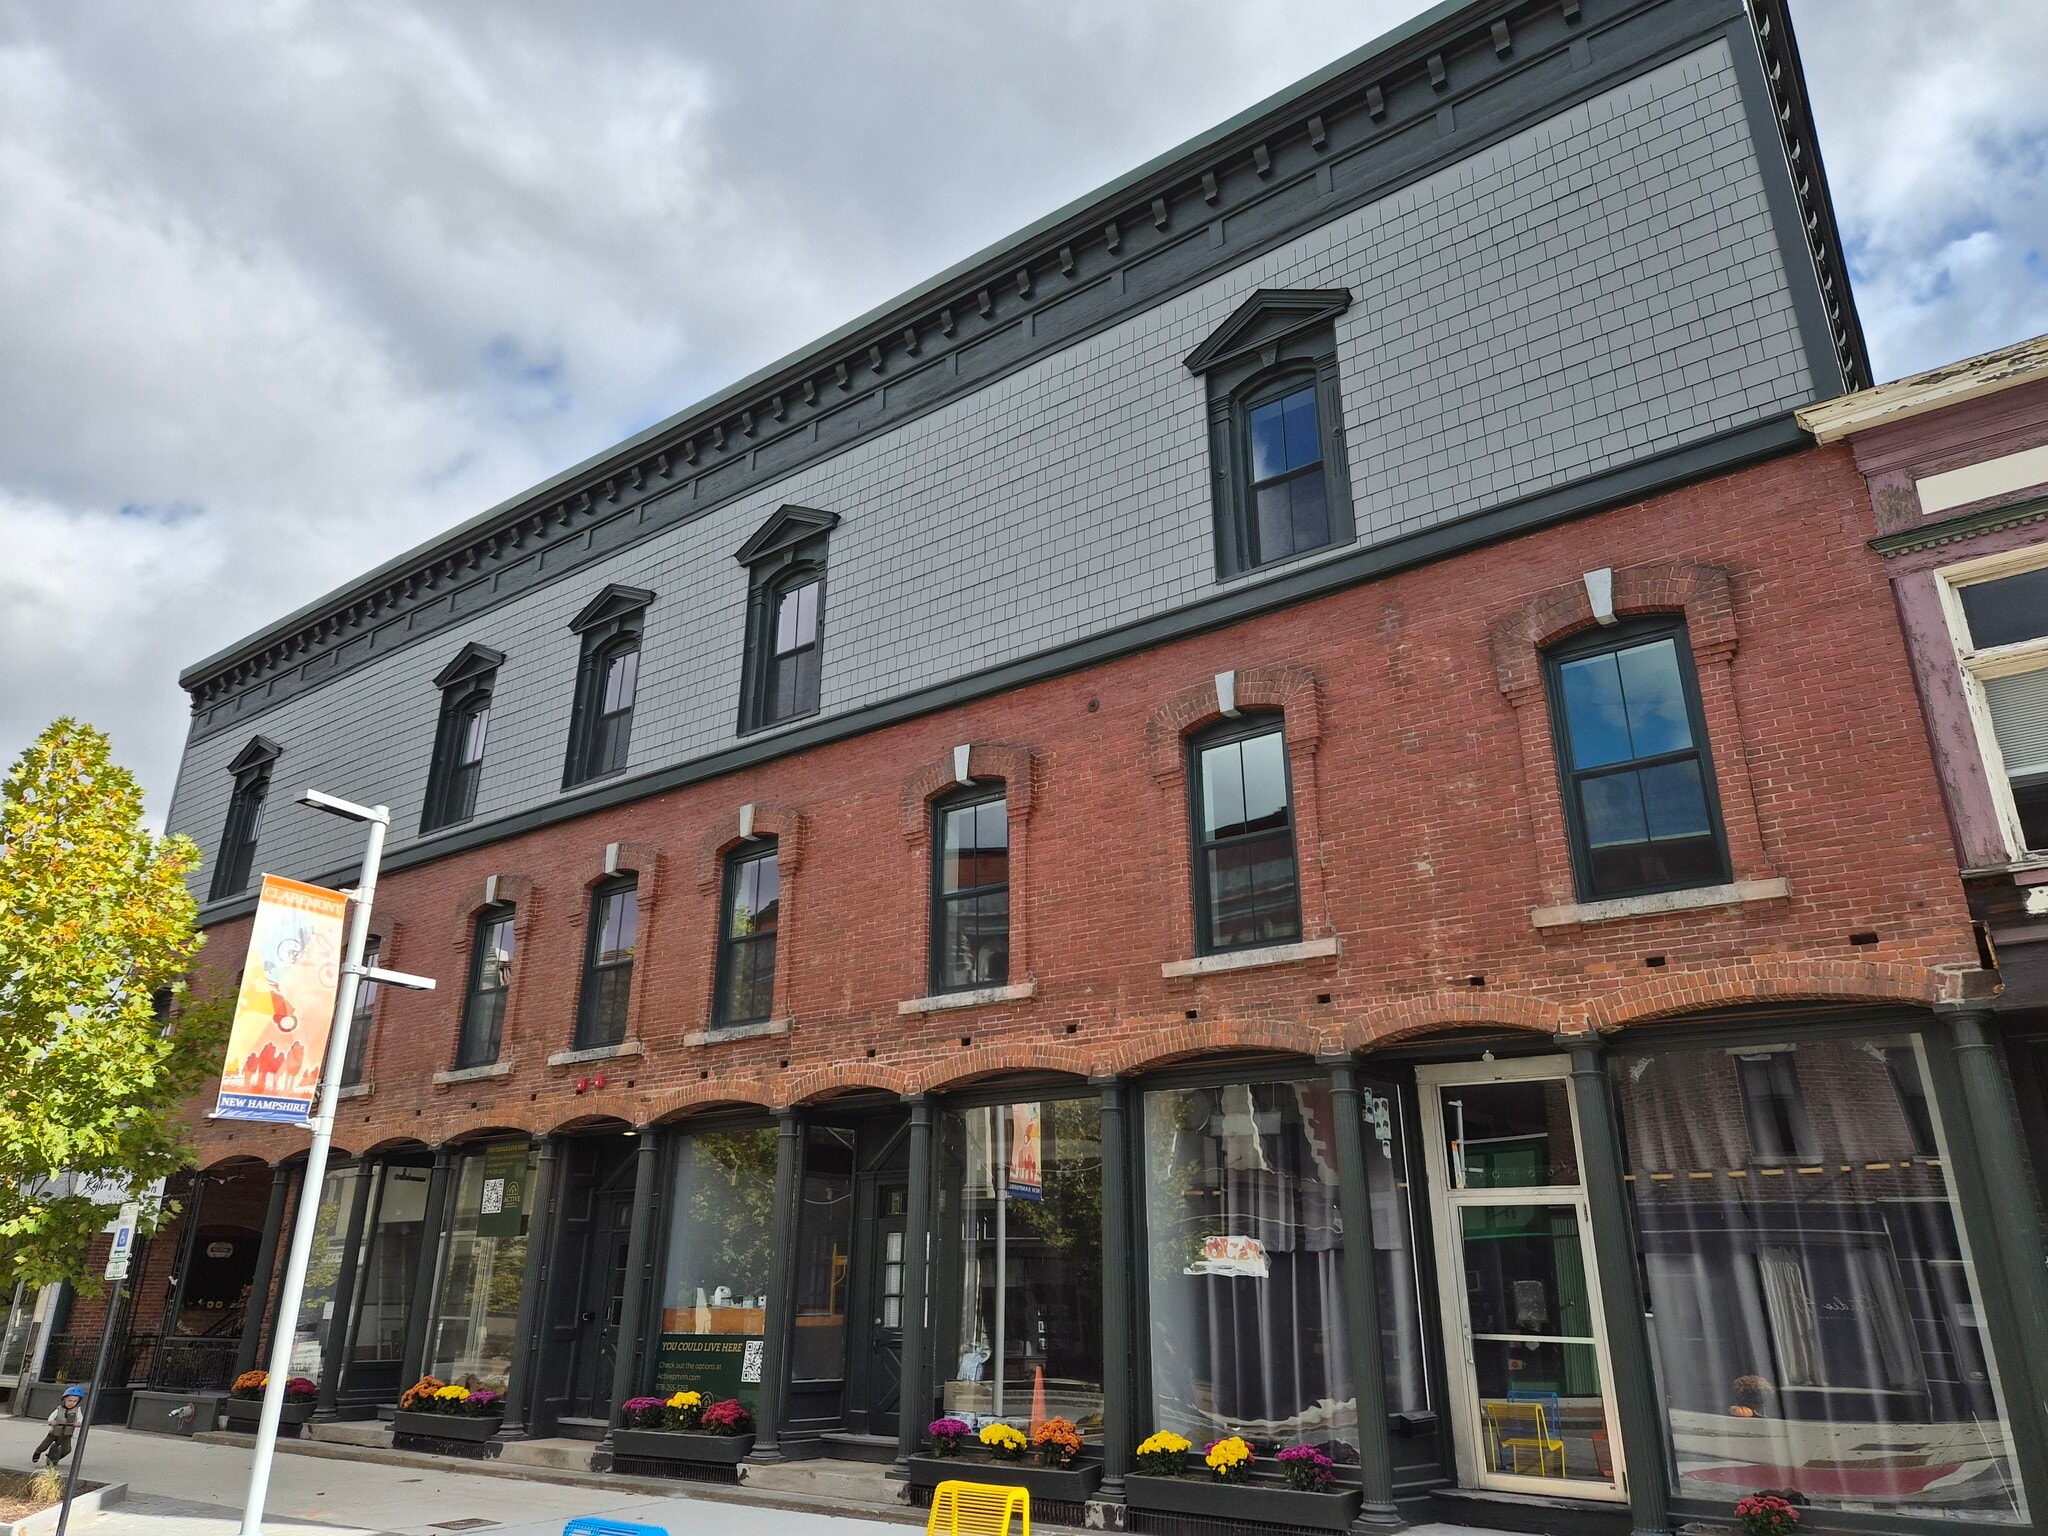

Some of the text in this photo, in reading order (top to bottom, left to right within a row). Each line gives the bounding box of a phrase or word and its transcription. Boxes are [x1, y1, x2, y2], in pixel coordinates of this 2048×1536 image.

[264, 887, 343, 913] CLAREMONT
[221, 1097, 307, 1112] NEW HAMPSHIRE
[662, 1342, 743, 1352] YOU COULD LIVE HERE
[659, 1361, 675, 1369] Check
[685, 1362, 695, 1370] the
[695, 1363, 716, 1371] options
